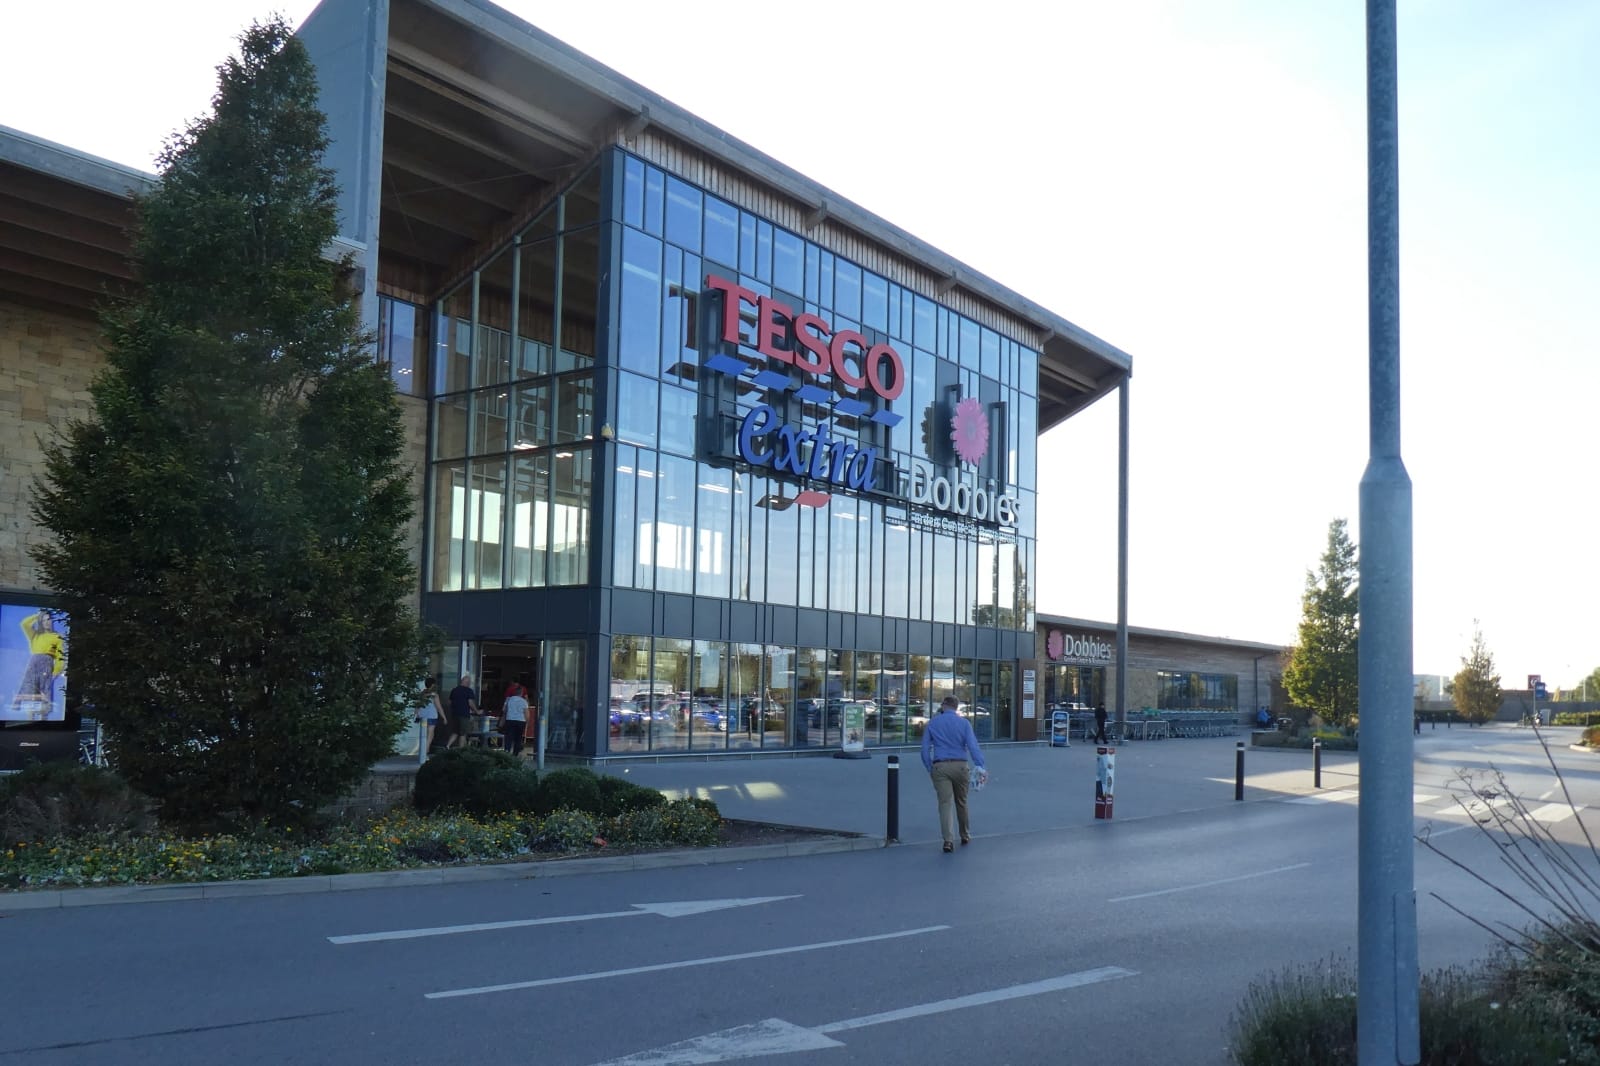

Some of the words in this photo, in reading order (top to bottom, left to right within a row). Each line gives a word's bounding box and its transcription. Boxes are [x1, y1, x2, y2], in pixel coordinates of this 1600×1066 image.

[706, 274, 905, 401] TESCO
[739, 404, 878, 492] extra
[910, 460, 1020, 529] Dobbies
[1065, 634, 1111, 659] Dobbies
